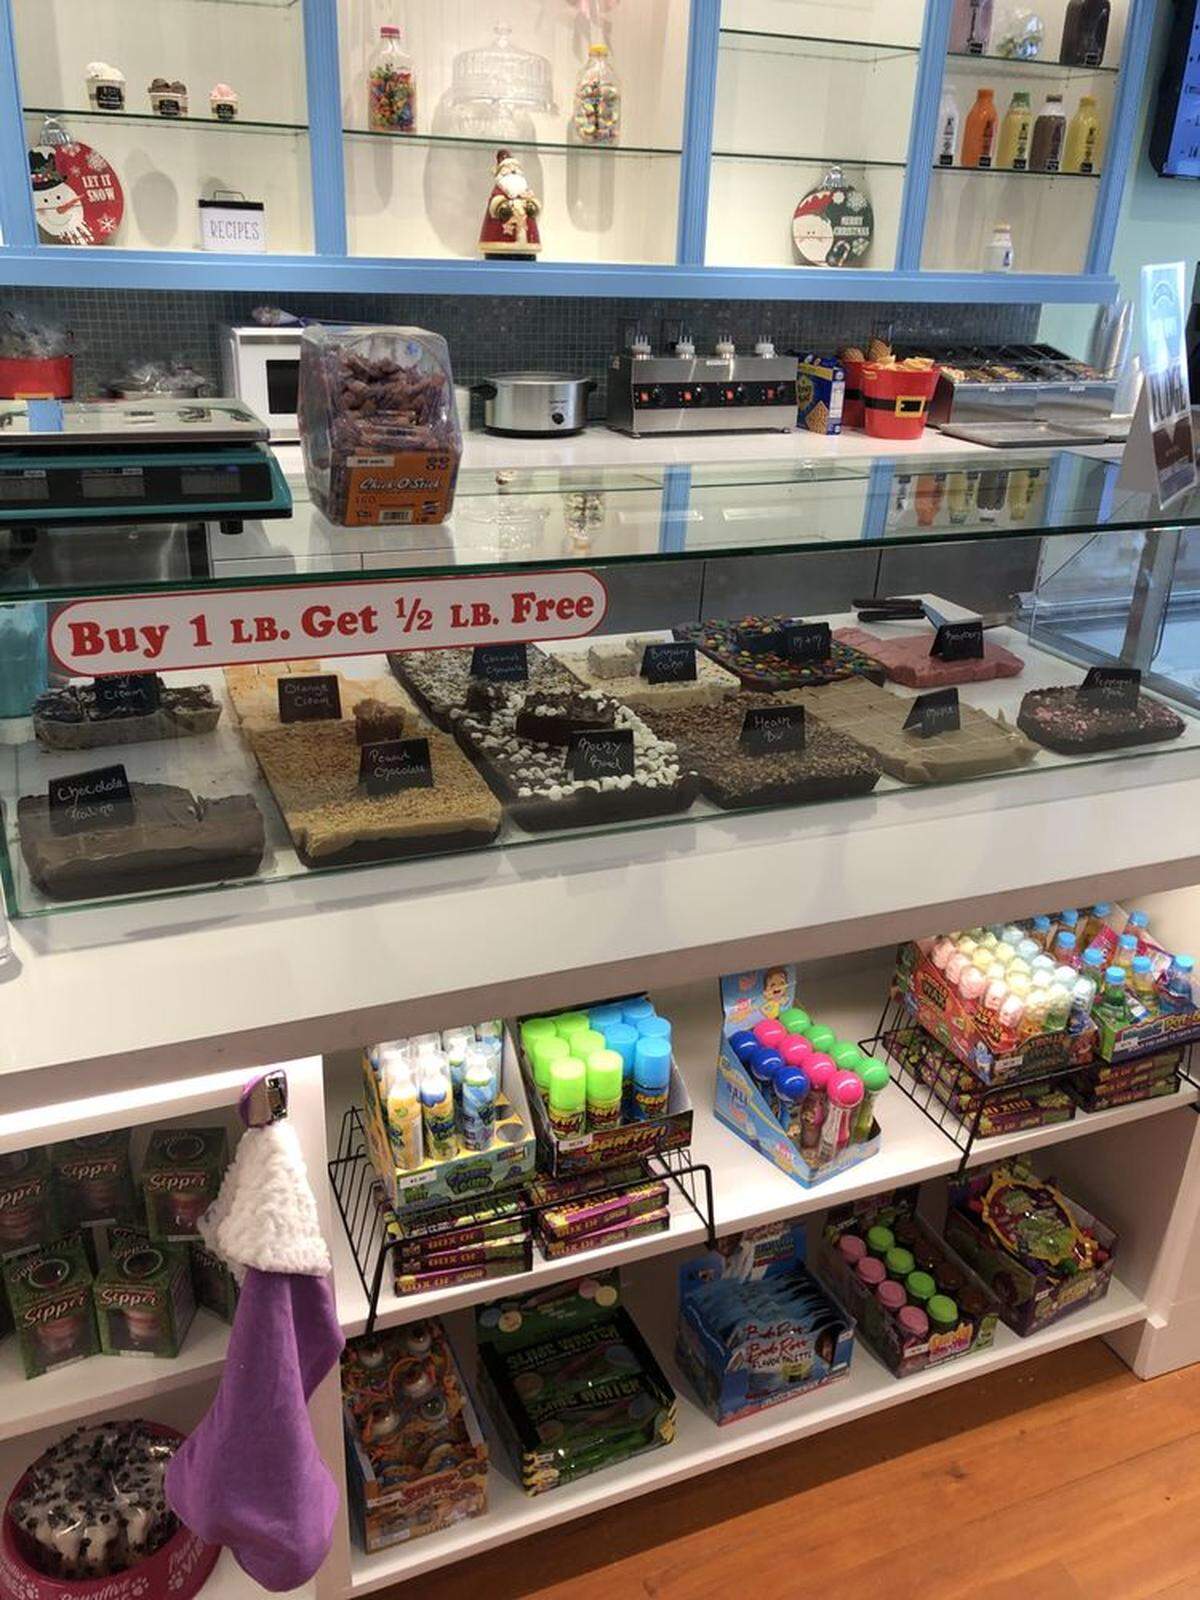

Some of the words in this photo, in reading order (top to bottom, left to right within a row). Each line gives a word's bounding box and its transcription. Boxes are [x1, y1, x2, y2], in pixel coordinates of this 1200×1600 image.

[82, 175, 100, 188] LET
[101, 174, 112, 186] IT
[86, 188, 116, 203] SNOW
[209, 220, 260, 241] RECIPES
[68, 621, 170, 658] Buy
[189, 614, 212, 647] 1
[230, 616, 291, 644] LB.
[301, 605, 379, 638] Get
[450, 602, 500, 629] LB.
[511, 591, 595, 623] Free
